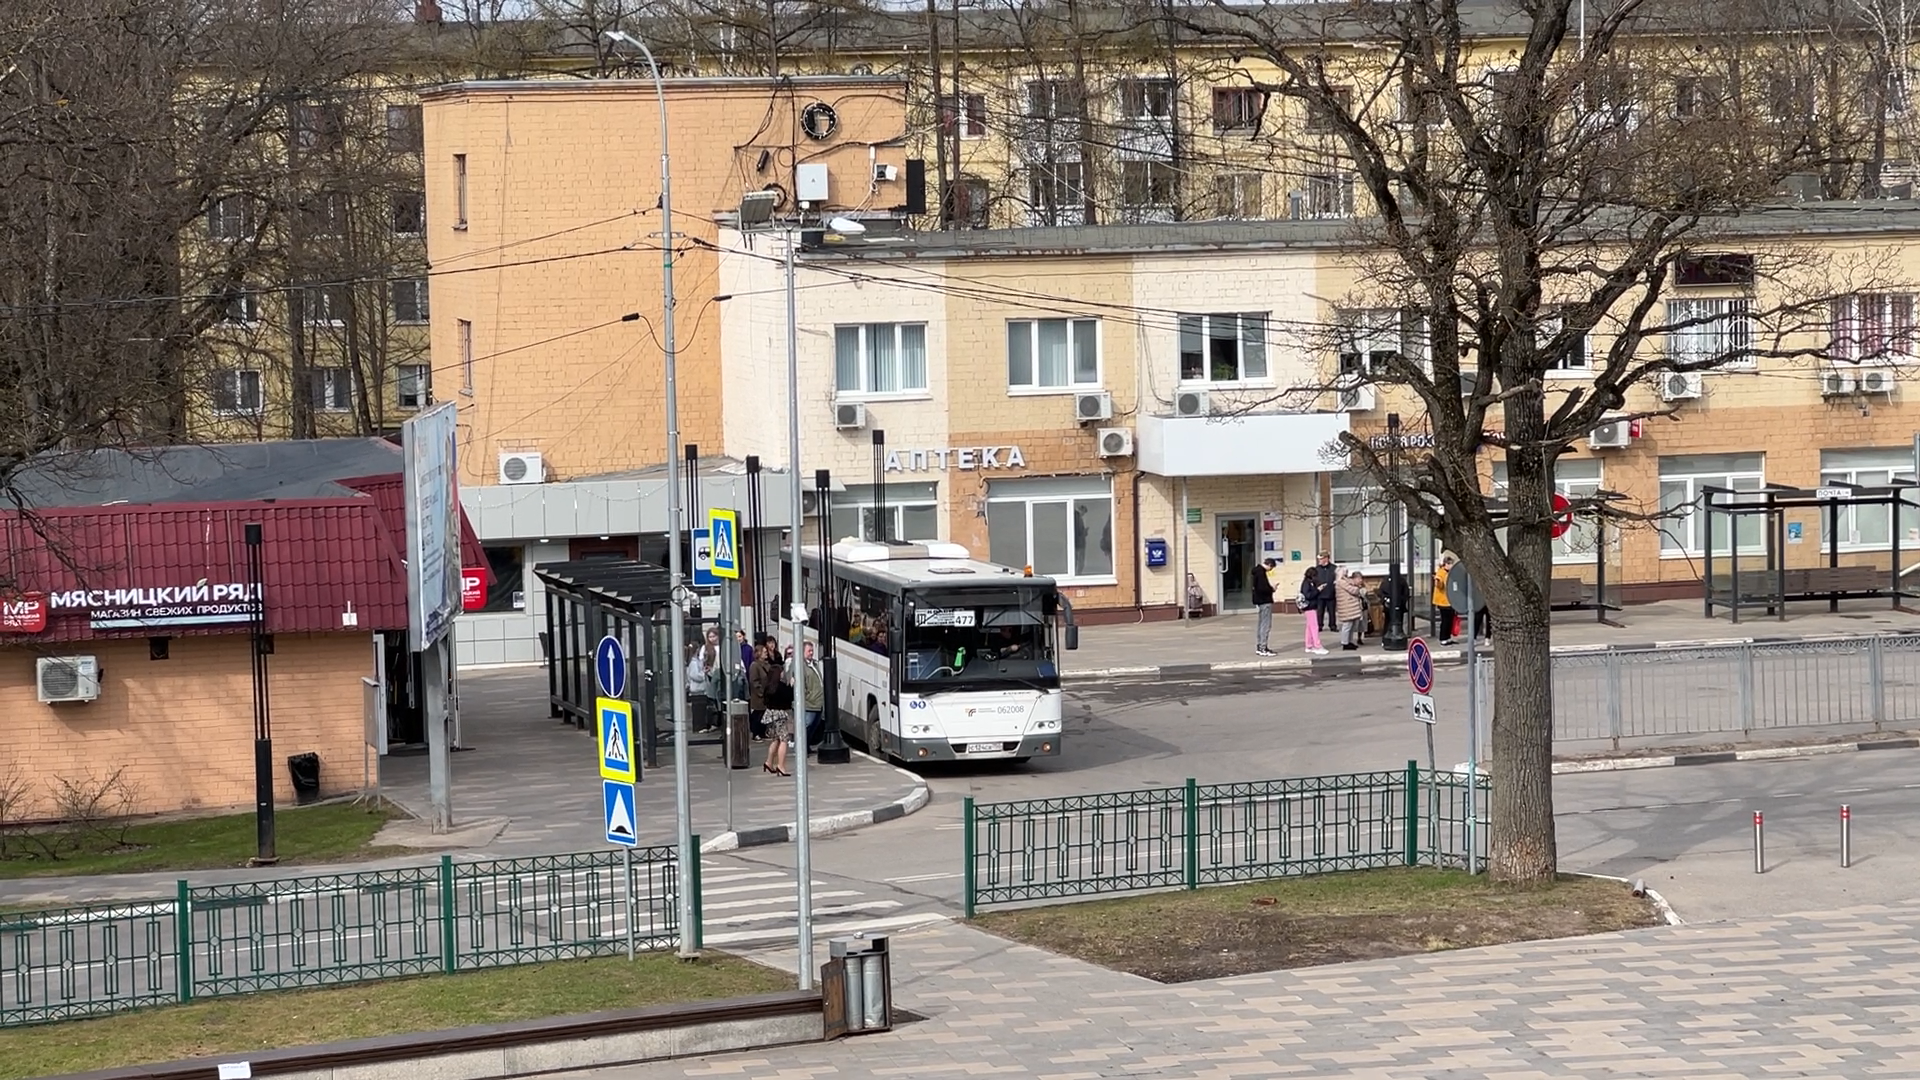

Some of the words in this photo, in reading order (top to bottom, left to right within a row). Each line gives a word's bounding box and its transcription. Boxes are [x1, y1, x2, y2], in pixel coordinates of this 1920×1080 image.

[884, 445, 1025, 470] АПТЕКА
[50, 580, 208, 609] МЯСНИЦКИЙ
[3, 600, 40, 615] МР
[90, 608, 142, 619] МАГАЗИН
[145, 605, 193, 617] СВЕЖИХ
[955, 615, 974, 625] 477
[997, 705, 1024, 714] 062008
